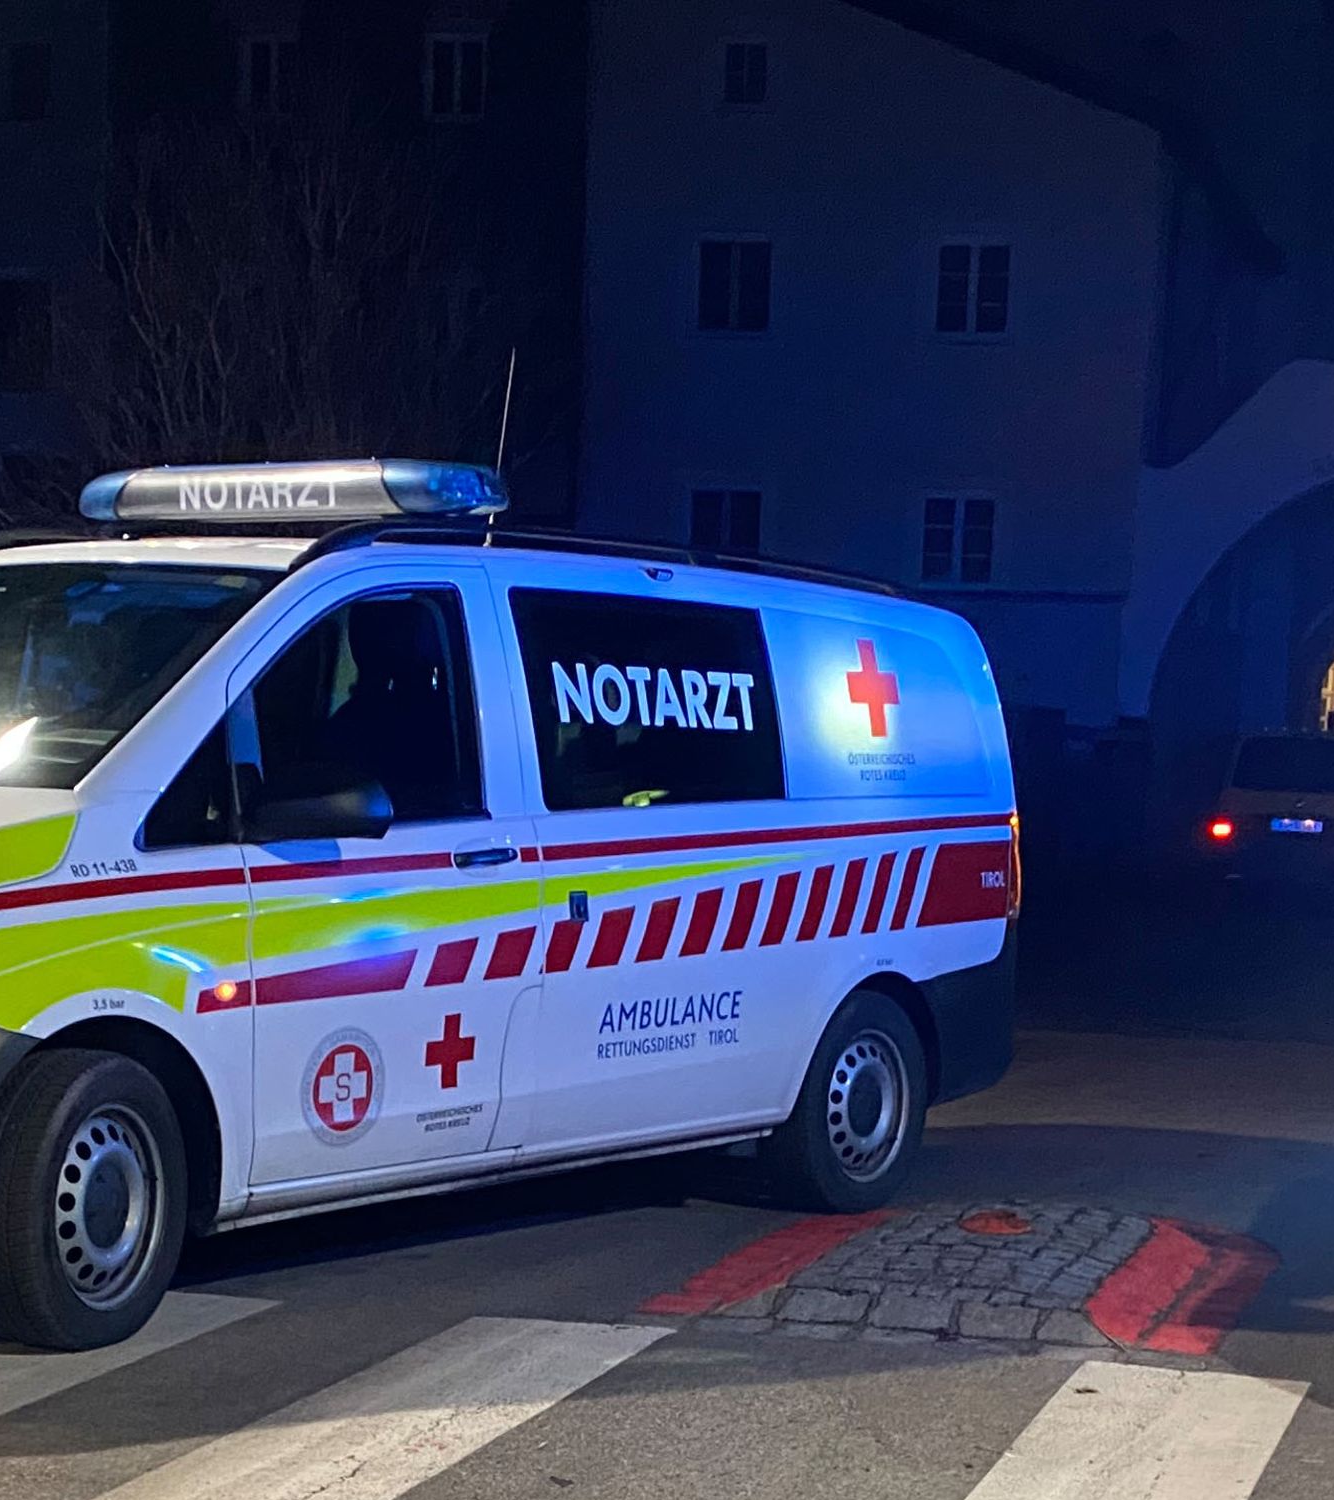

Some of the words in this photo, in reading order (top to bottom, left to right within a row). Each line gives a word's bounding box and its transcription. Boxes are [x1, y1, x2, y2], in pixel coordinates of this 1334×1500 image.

[179, 479, 336, 511] NOTARZT
[551, 661, 755, 731] NOTARZT
[70, 863, 90, 877] RD
[92, 858, 138, 876] 11-438
[980, 870, 1006, 889] TIROL
[598, 990, 743, 1035] AMBULANCE
[597, 1032, 697, 1060] RETTUNGSDIENST
[708, 1028, 740, 1046] TIROL
[335, 1072, 352, 1101] S
